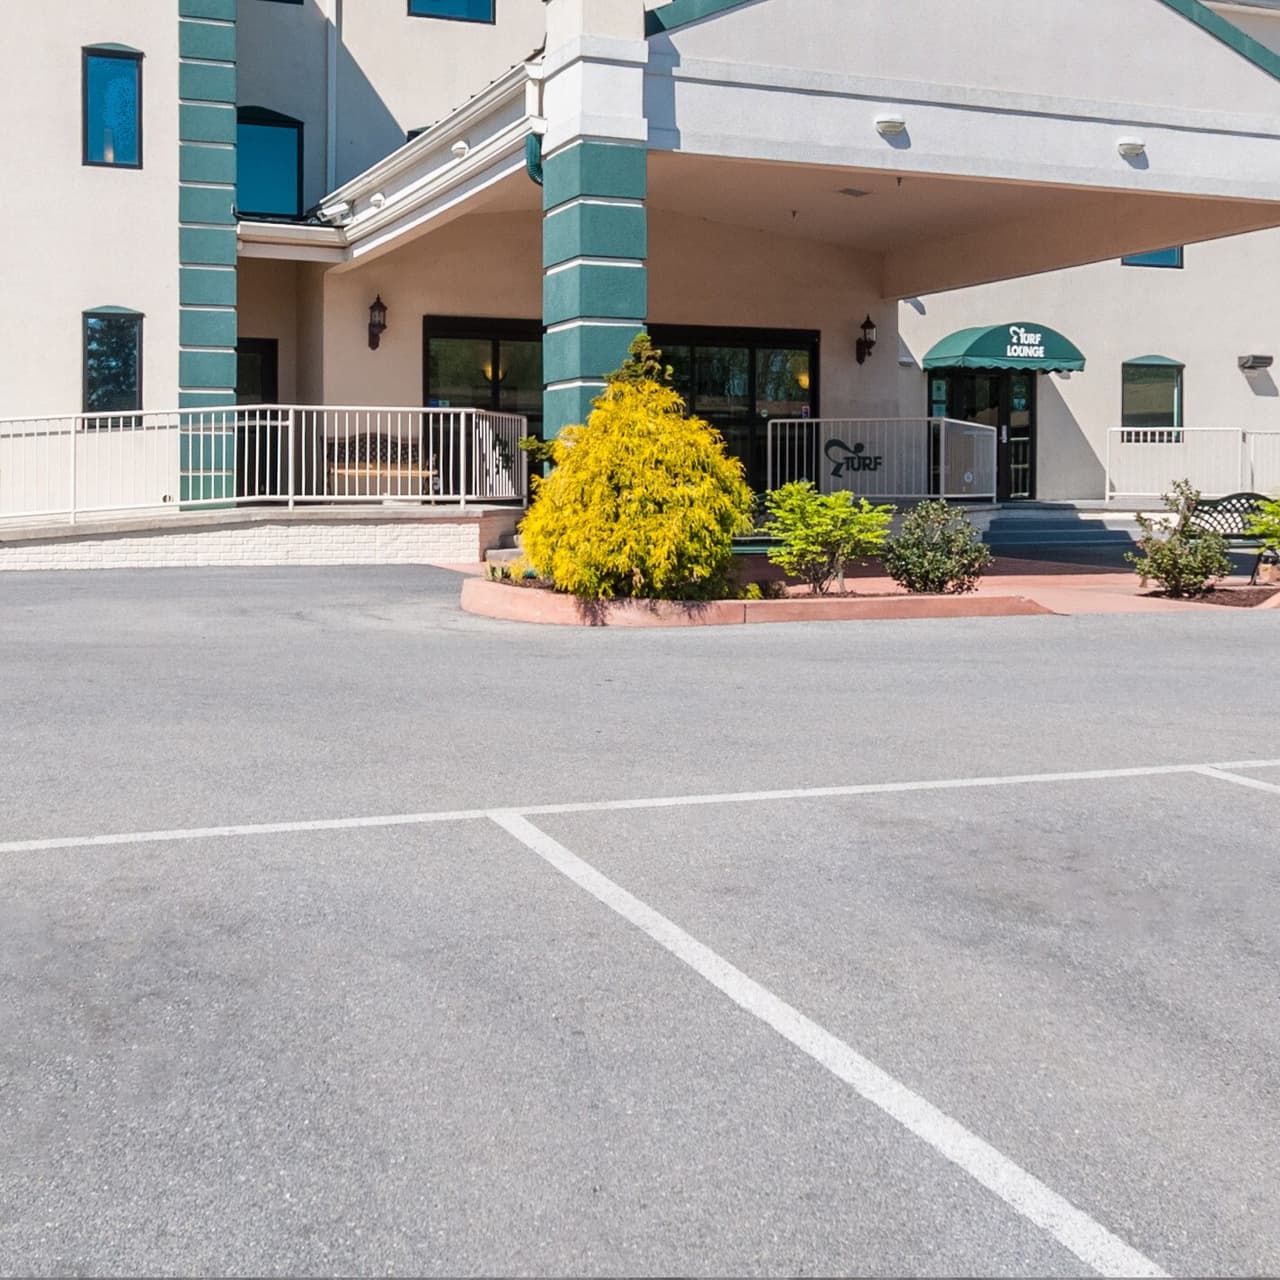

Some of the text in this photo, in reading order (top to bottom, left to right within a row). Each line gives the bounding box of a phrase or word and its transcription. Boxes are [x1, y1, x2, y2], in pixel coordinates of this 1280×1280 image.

[1019, 333, 1042, 345] TURF
[1006, 345, 1045, 358] LOUNGE
[843, 455, 882, 472] TURF
